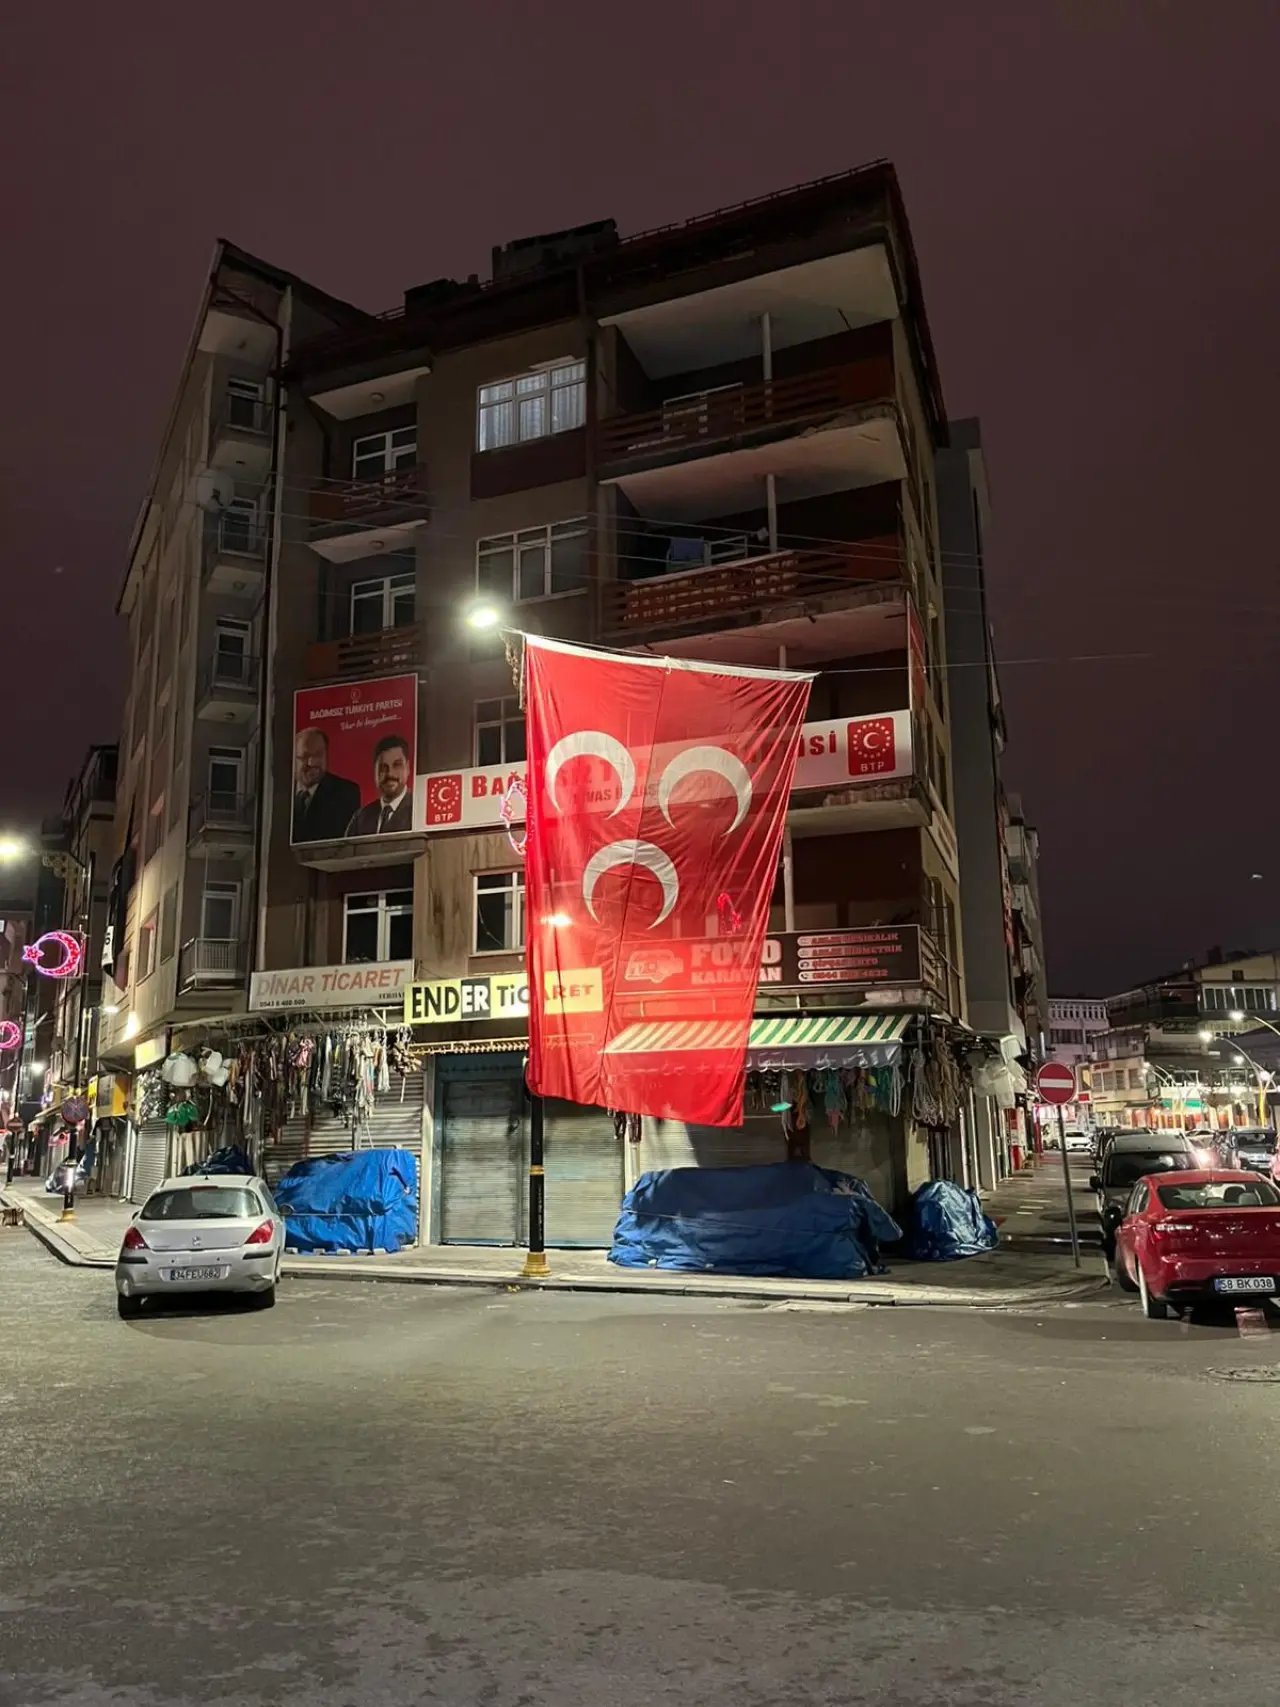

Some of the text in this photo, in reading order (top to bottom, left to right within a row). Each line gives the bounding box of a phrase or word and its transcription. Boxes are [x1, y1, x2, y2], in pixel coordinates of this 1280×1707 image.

[860, 761, 885, 772] BTP
[434, 813, 454, 822] BTP
[691, 939, 782, 966] FOTO
[254, 968, 405, 997] DİNAR TİCARET
[412, 985, 490, 1019] ENDER
[1220, 1278, 1273, 1289] 58 BK 038
